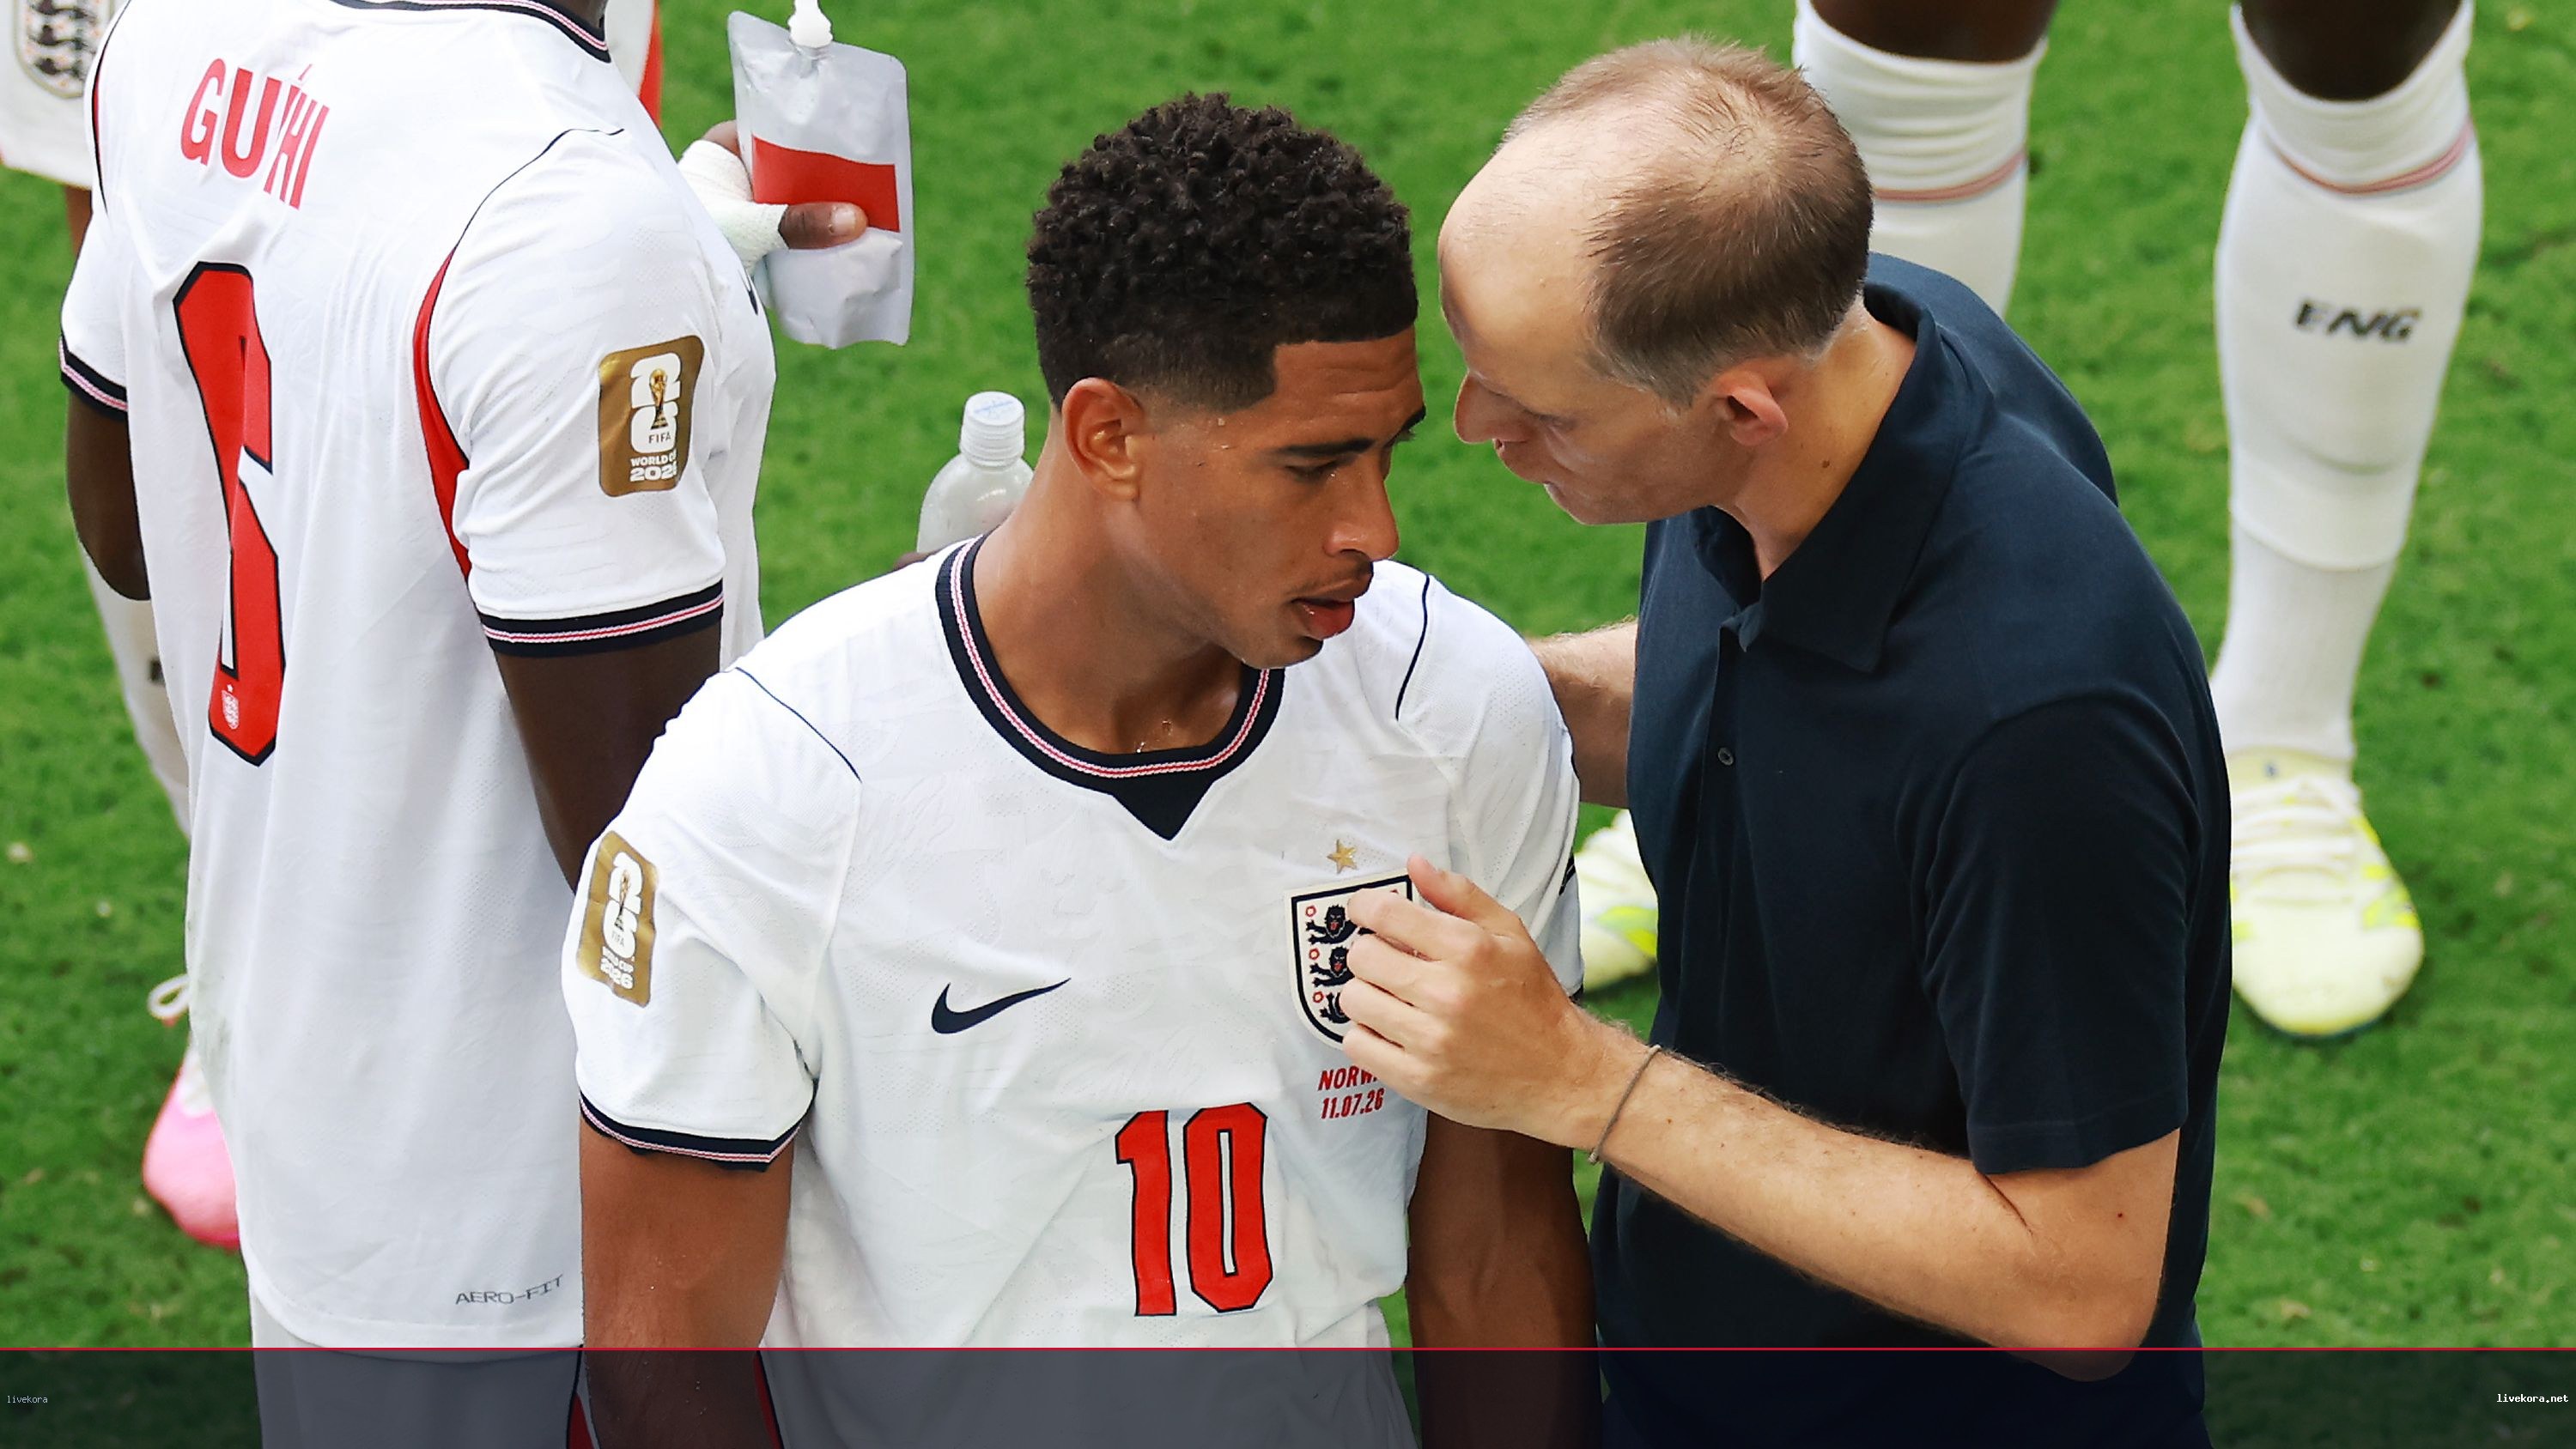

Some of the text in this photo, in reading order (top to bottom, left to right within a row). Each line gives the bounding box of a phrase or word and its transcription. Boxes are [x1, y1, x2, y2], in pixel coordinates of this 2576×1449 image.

[2295, 300, 2421, 343] ENG
[648, 432, 671, 444] FIFA
[630, 455, 668, 467] WORLD
[1318, 1065, 1377, 1091] NORW
[1321, 1088, 1385, 1119] 11.07.26
[1115, 1102, 1273, 1317] 10
[456, 1274, 563, 1305] AERO-FIT
